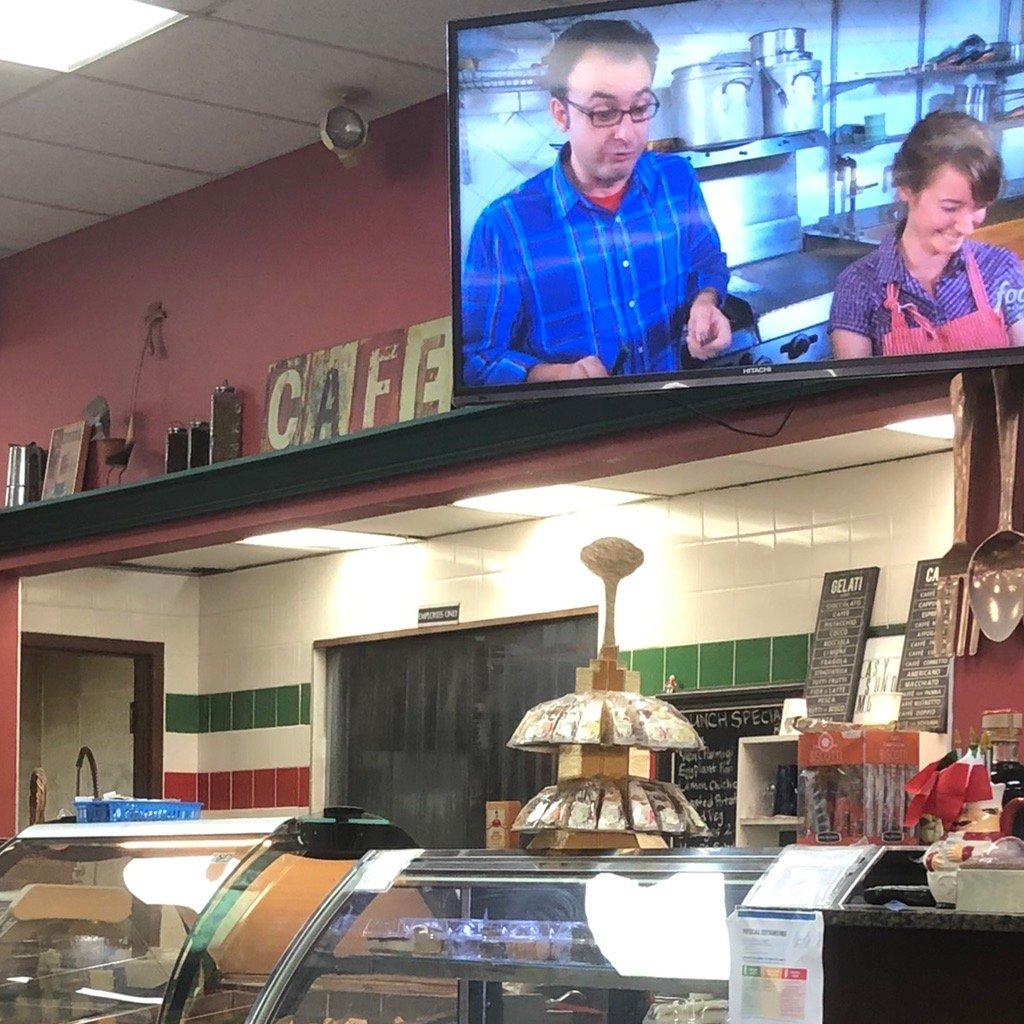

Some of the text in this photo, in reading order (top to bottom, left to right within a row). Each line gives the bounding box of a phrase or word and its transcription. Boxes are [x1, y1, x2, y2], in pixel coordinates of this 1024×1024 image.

[743, 366, 772, 374] HITACHI
[267, 317, 453, 450] CAFE
[830, 576, 864, 594] GELATI
[690, 709, 782, 729] UNCH SPECIA
